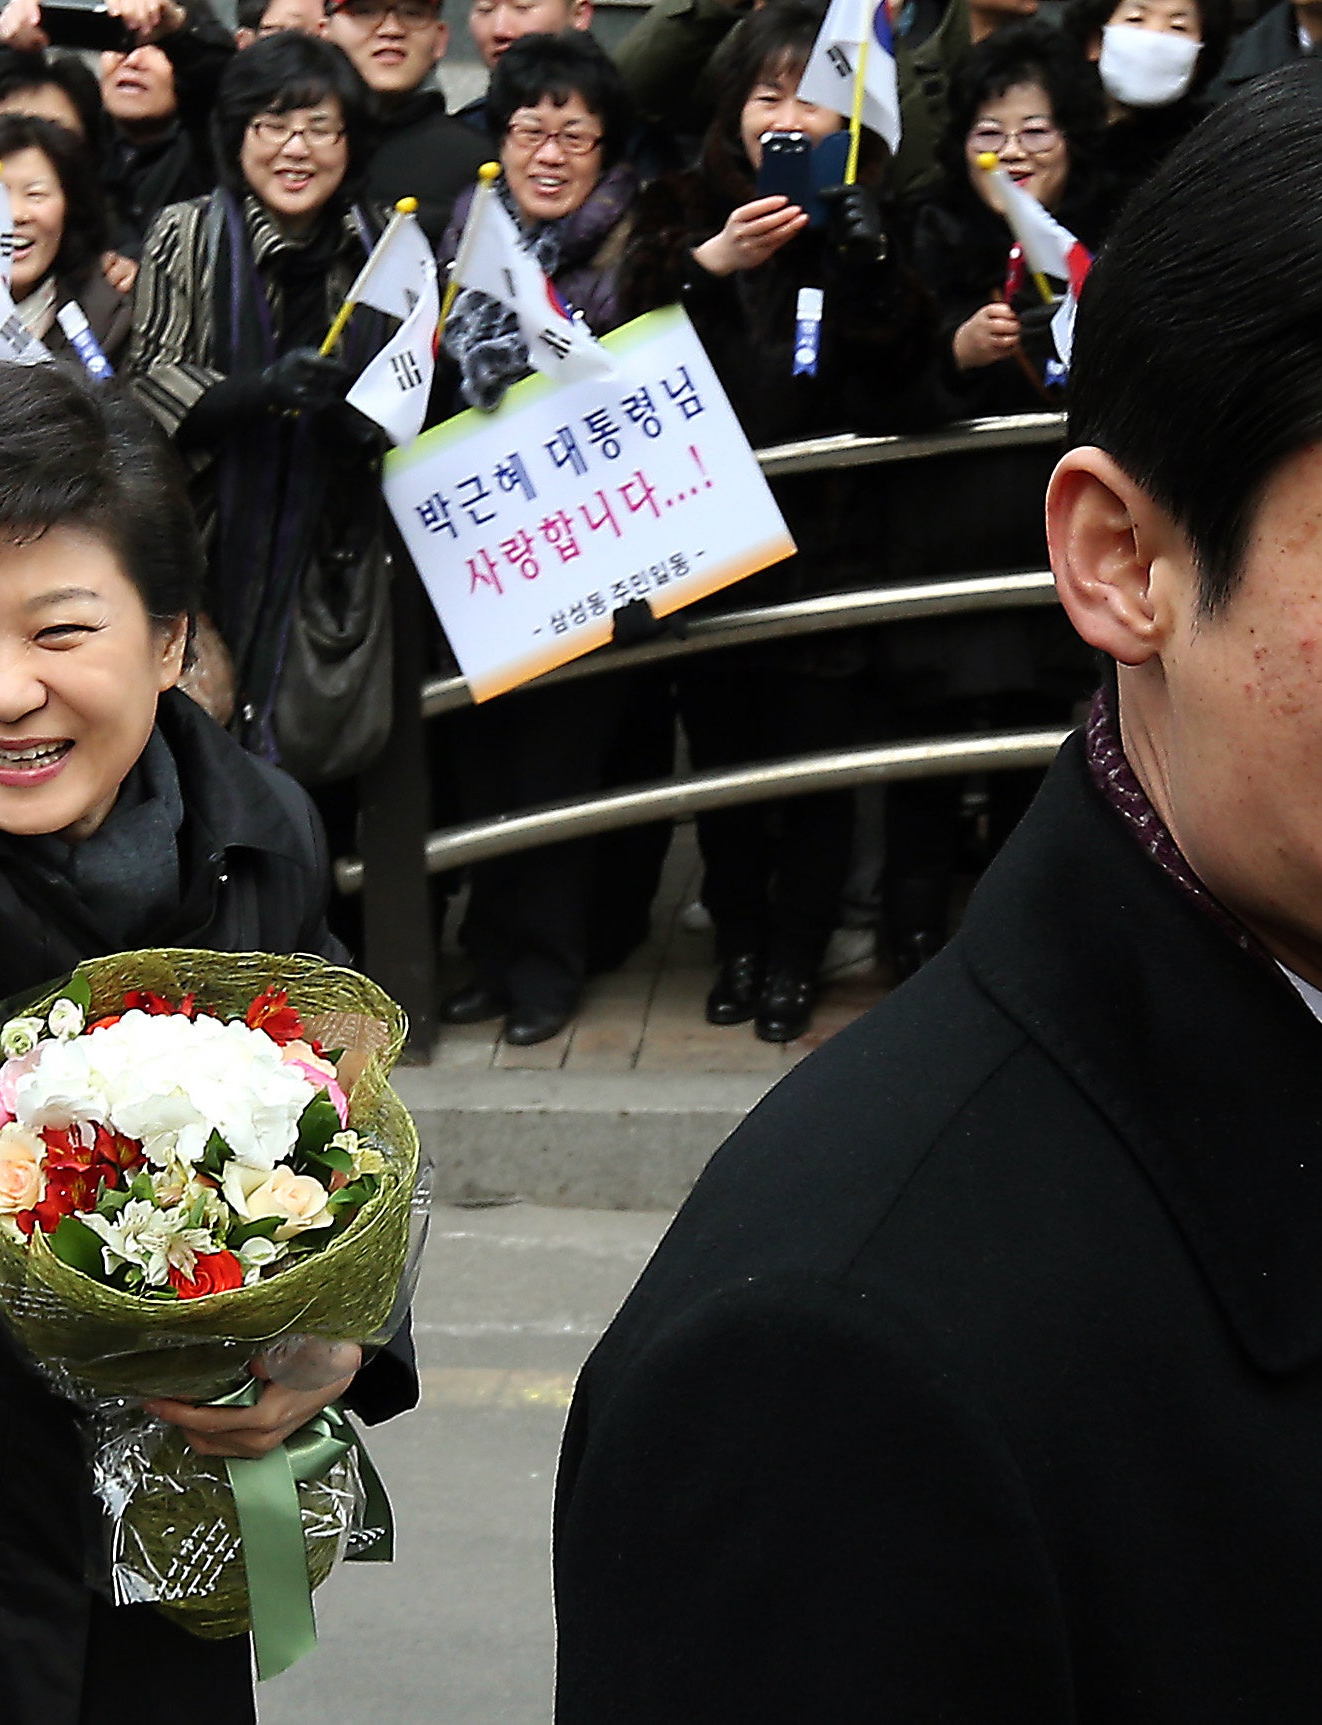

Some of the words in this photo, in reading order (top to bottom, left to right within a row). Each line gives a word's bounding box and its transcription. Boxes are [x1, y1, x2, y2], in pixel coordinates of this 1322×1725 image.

[415, 452, 537, 539] 박근혜
[465, 445, 713, 595] 사랑합니다...!
[550, 591, 607, 634] 삼성동
